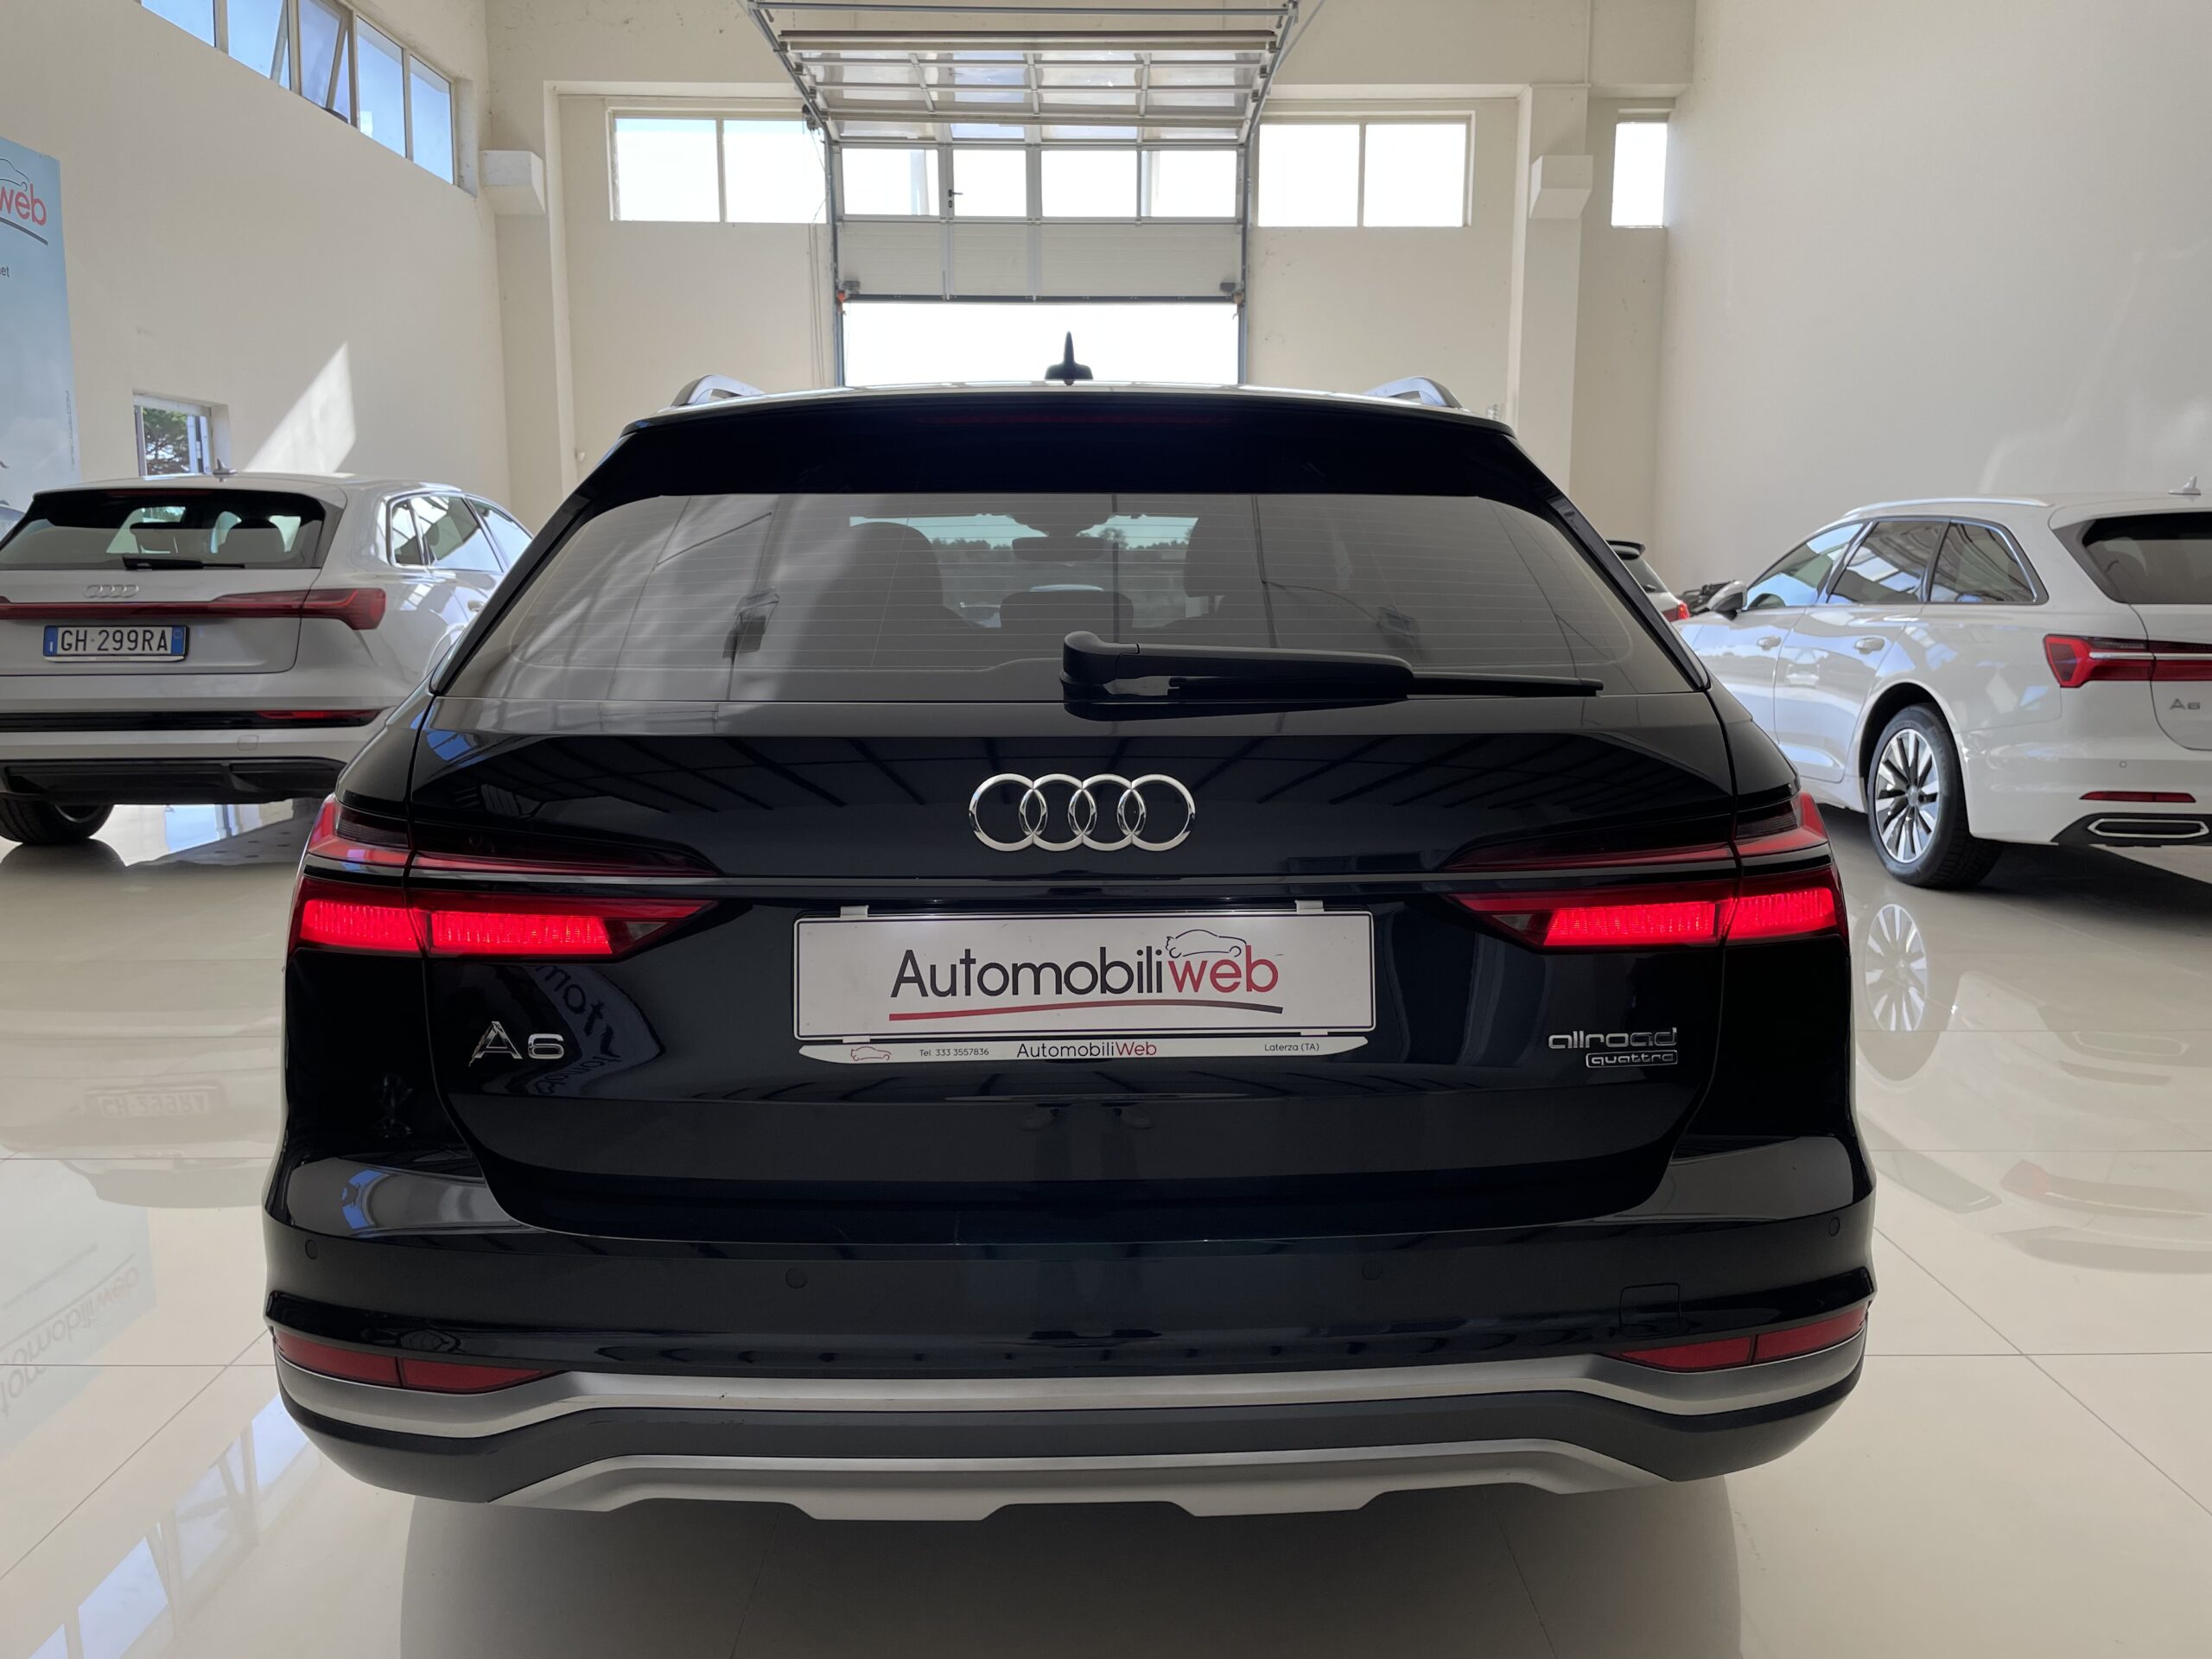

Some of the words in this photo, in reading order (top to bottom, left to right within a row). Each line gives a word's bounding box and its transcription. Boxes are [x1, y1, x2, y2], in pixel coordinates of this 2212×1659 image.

[2169, 697, 2201, 710] A6
[891, 944, 1279, 999] Automobiliweb
[467, 1020, 565, 1067] A6
[1548, 1027, 1677, 1049] allroad
[935, 1048, 951, 1057] 333
[953, 1047, 989, 1057] 3557836
[1016, 1041, 1157, 1058] AutomobiliWeb
[1264, 1043, 1299, 1052] Laterza
[1300, 1043, 1319, 1052] (TA)
